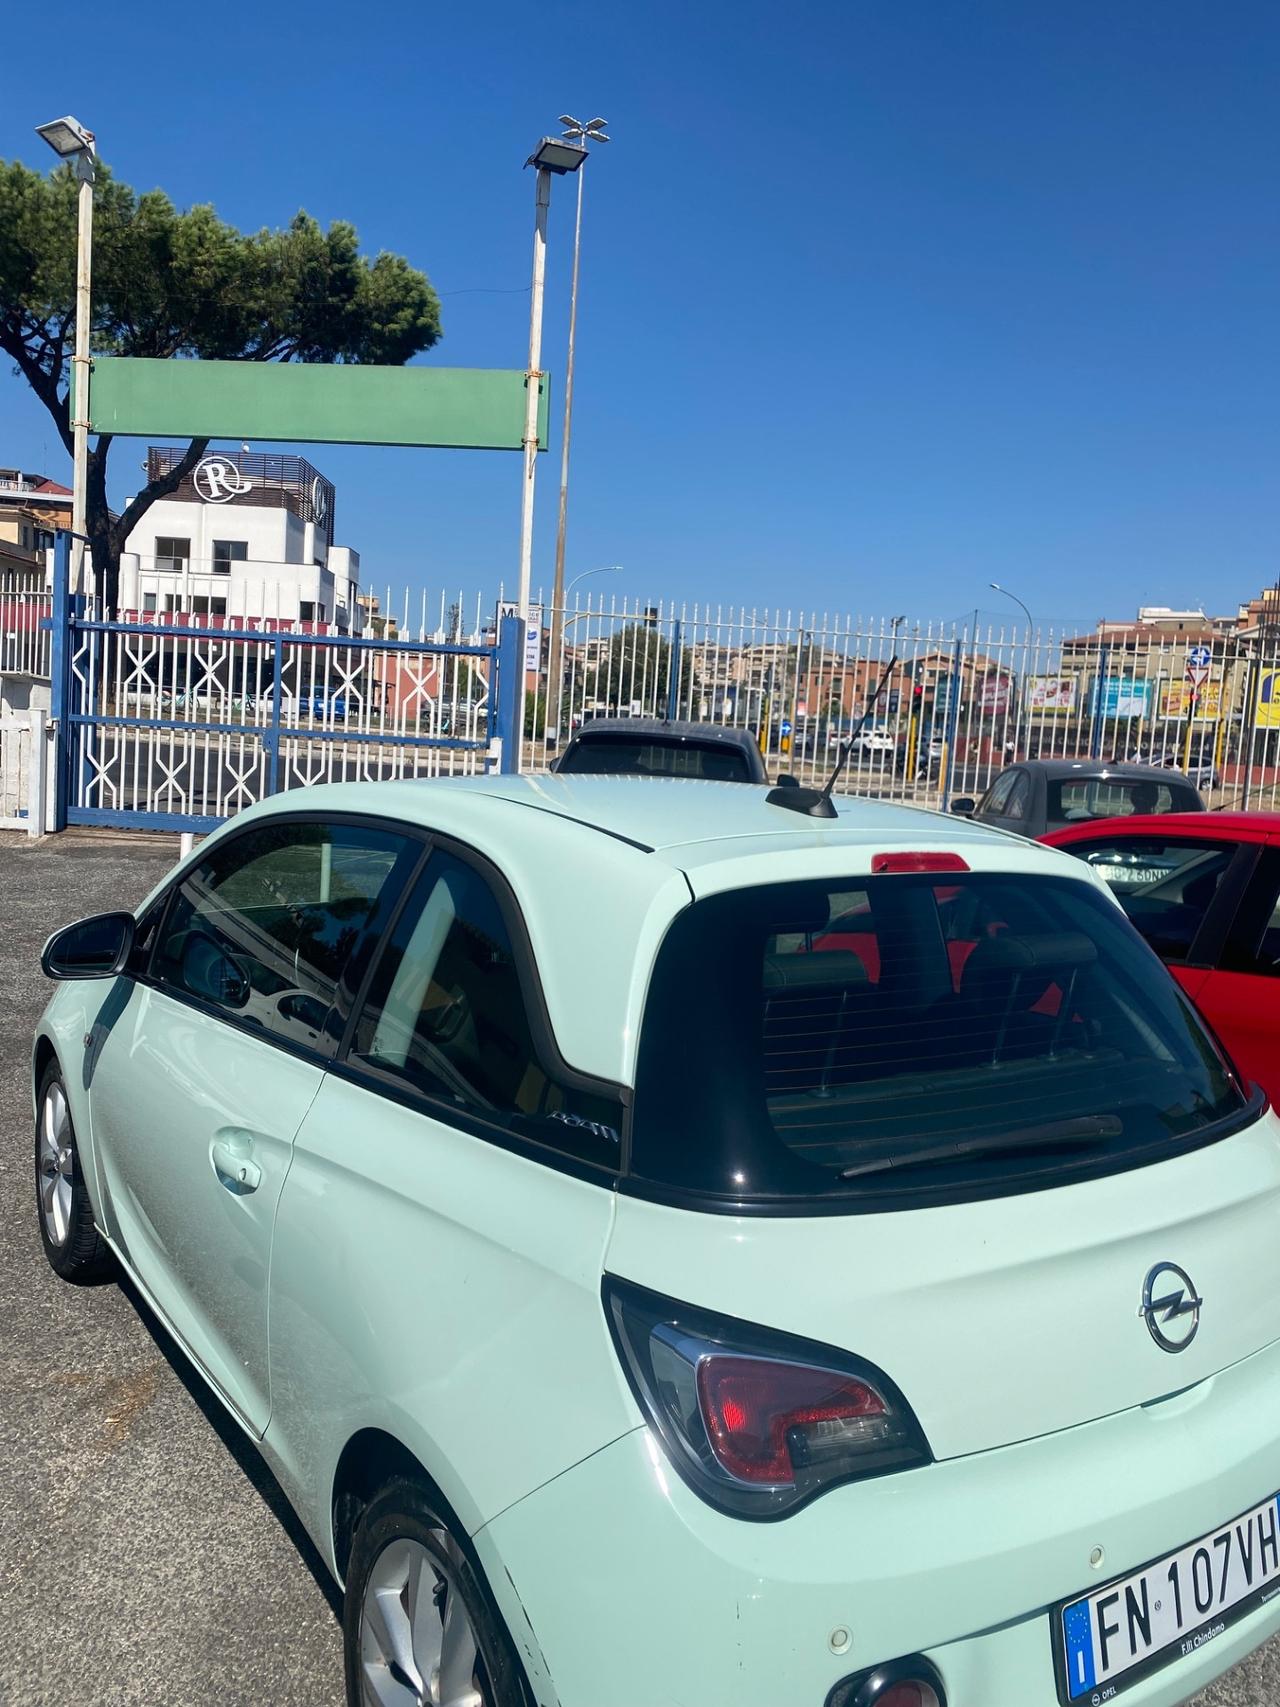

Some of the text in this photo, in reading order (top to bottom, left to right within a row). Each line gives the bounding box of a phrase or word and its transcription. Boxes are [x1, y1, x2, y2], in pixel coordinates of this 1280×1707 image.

[202, 462, 252, 499] R
[1096, 1507, 1279, 1671] FN 107VH
[1077, 1650, 1085, 1684] I
[1102, 1686, 1117, 1700] OPEL
